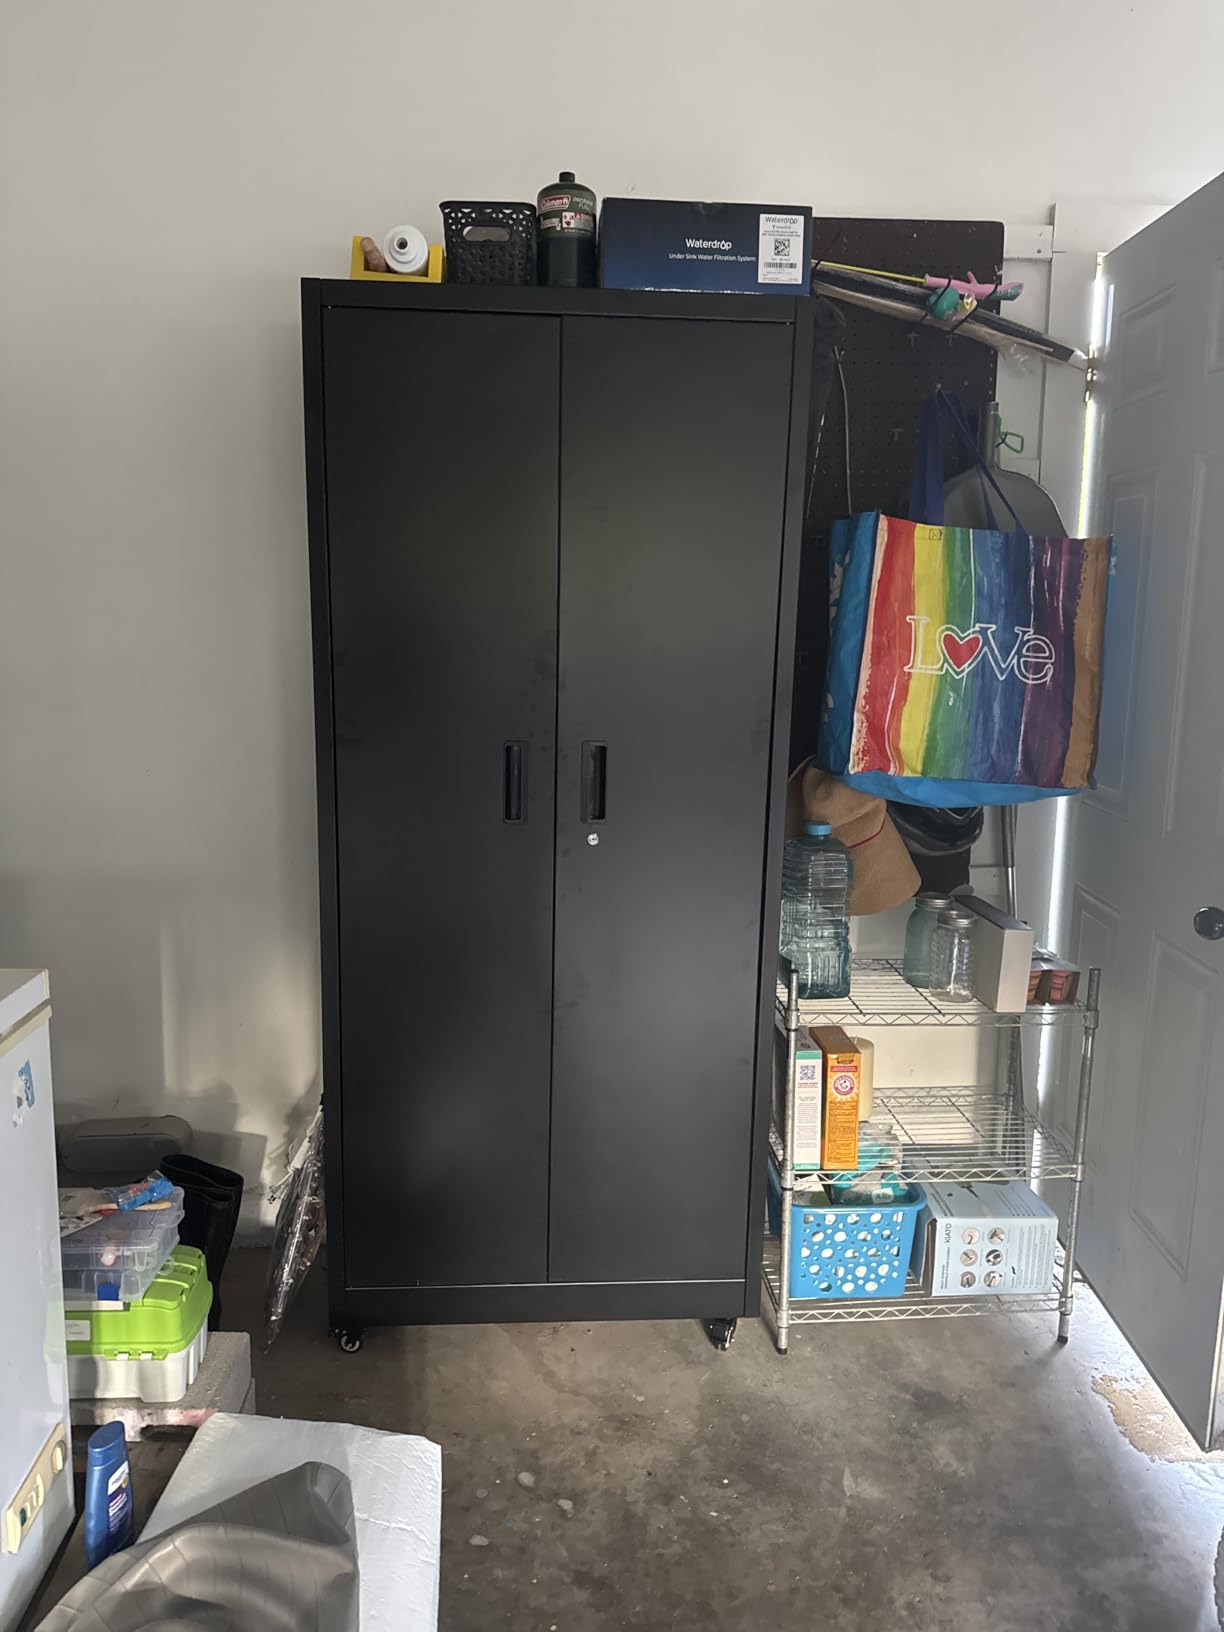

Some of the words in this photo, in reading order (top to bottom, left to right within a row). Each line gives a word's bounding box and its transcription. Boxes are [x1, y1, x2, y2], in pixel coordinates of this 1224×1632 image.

[765, 216, 798, 224] Waterdrop
[685, 238, 732, 251] Waterdrop
[944, 1223, 952, 1243] KIATO
